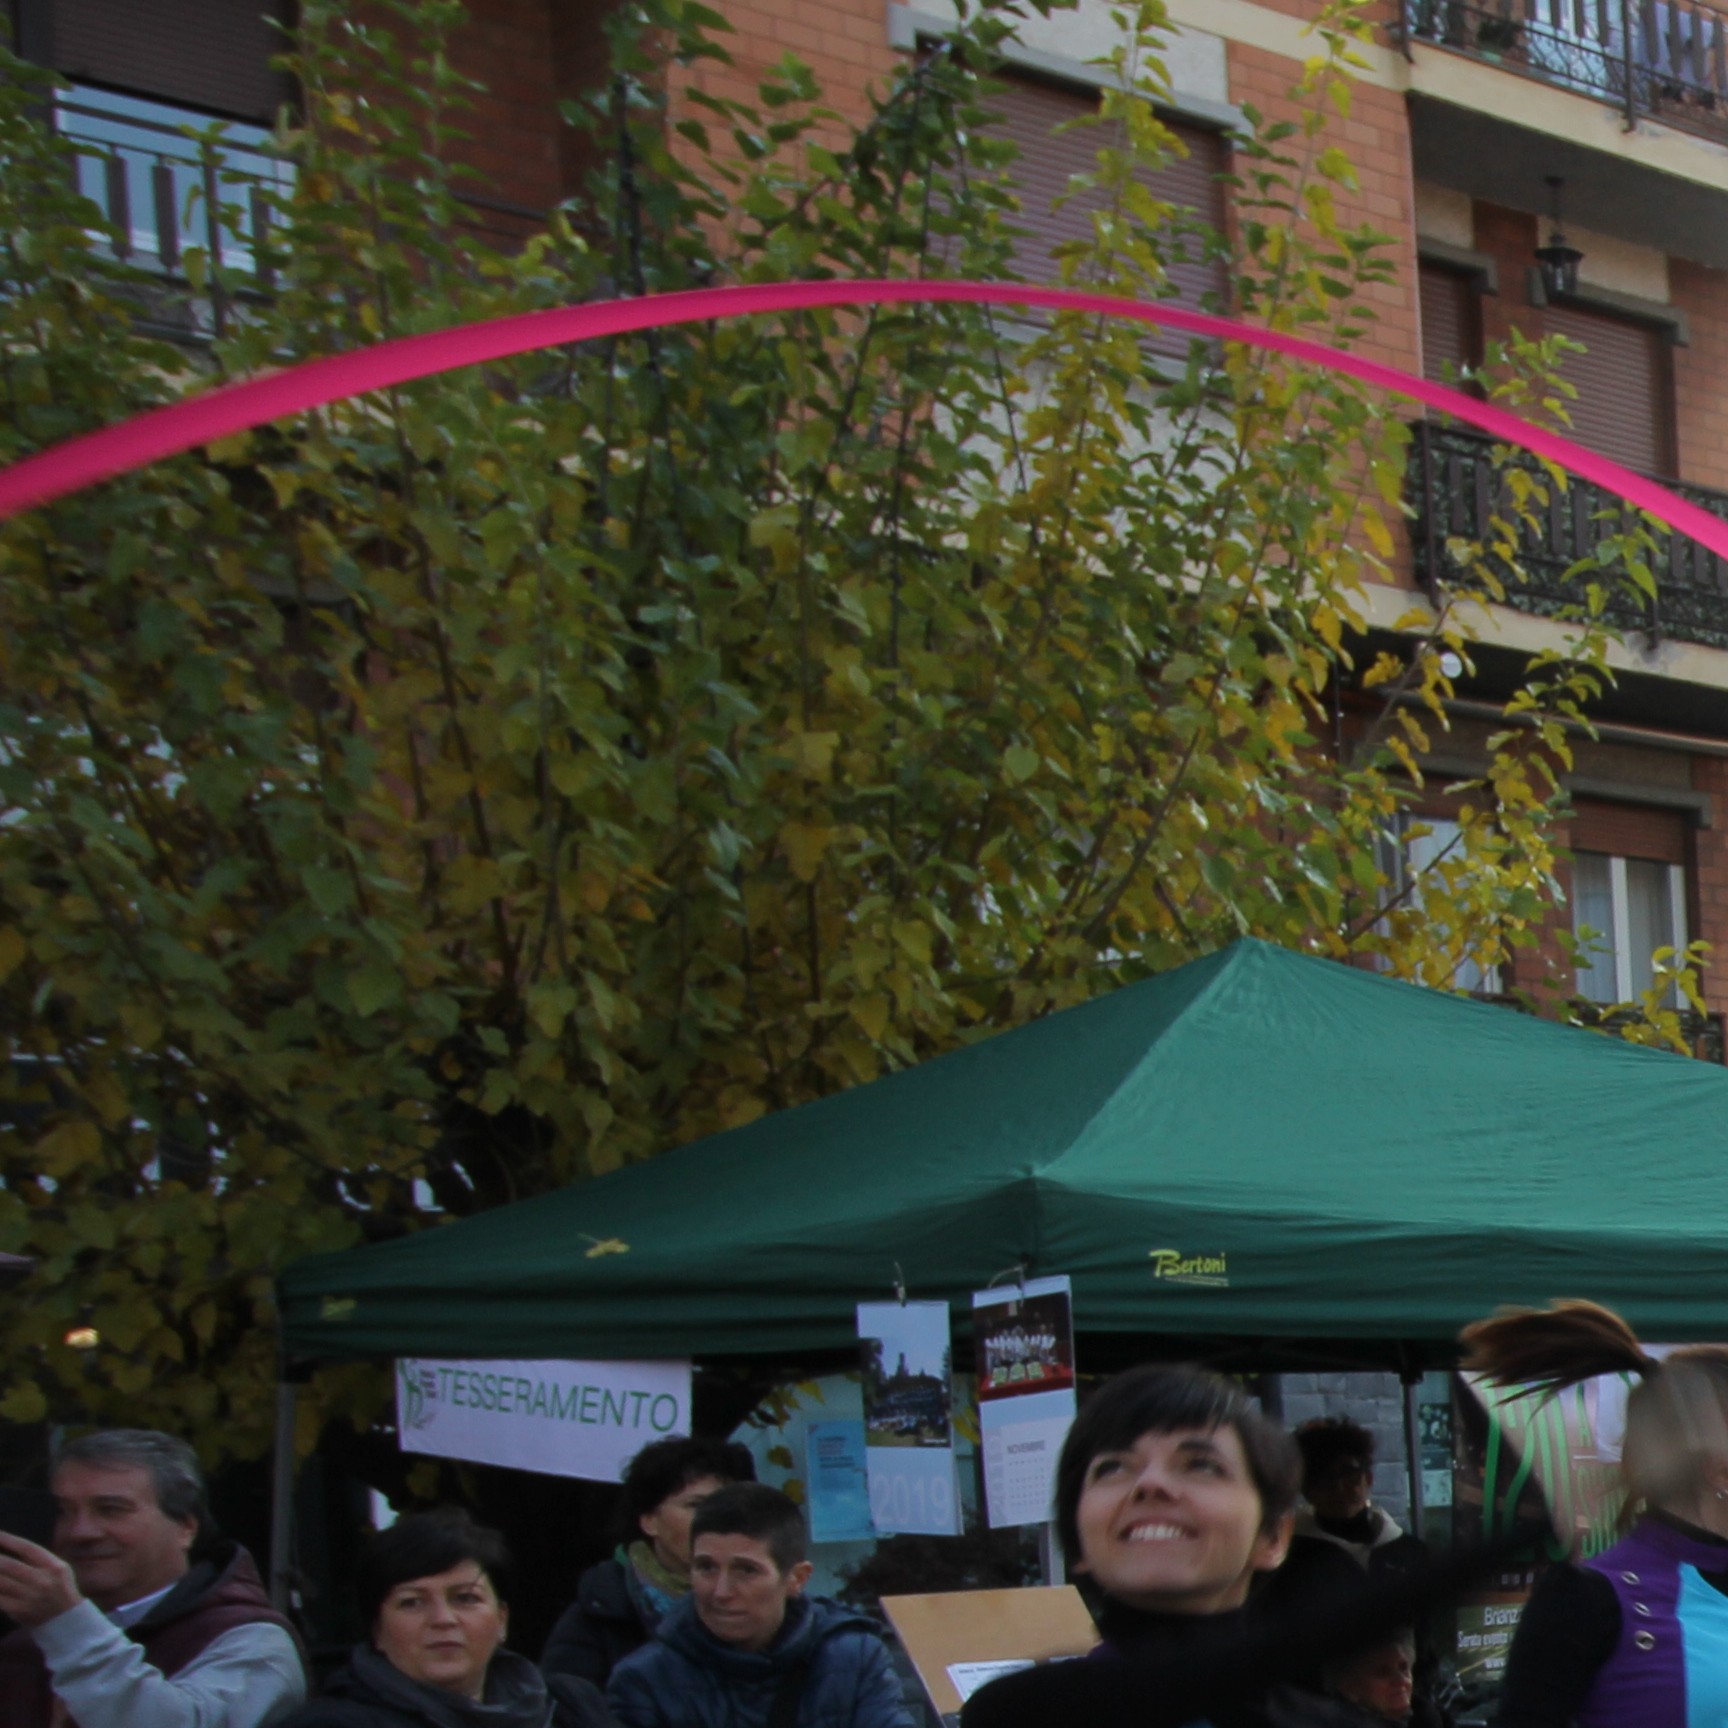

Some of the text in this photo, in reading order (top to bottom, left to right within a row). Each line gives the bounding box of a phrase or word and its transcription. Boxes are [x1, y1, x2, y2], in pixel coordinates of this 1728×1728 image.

[1148, 1248, 1226, 1278] Bertoni
[437, 1368, 680, 1433] TESSERAMENTO
[876, 1475, 950, 1526] 2019
